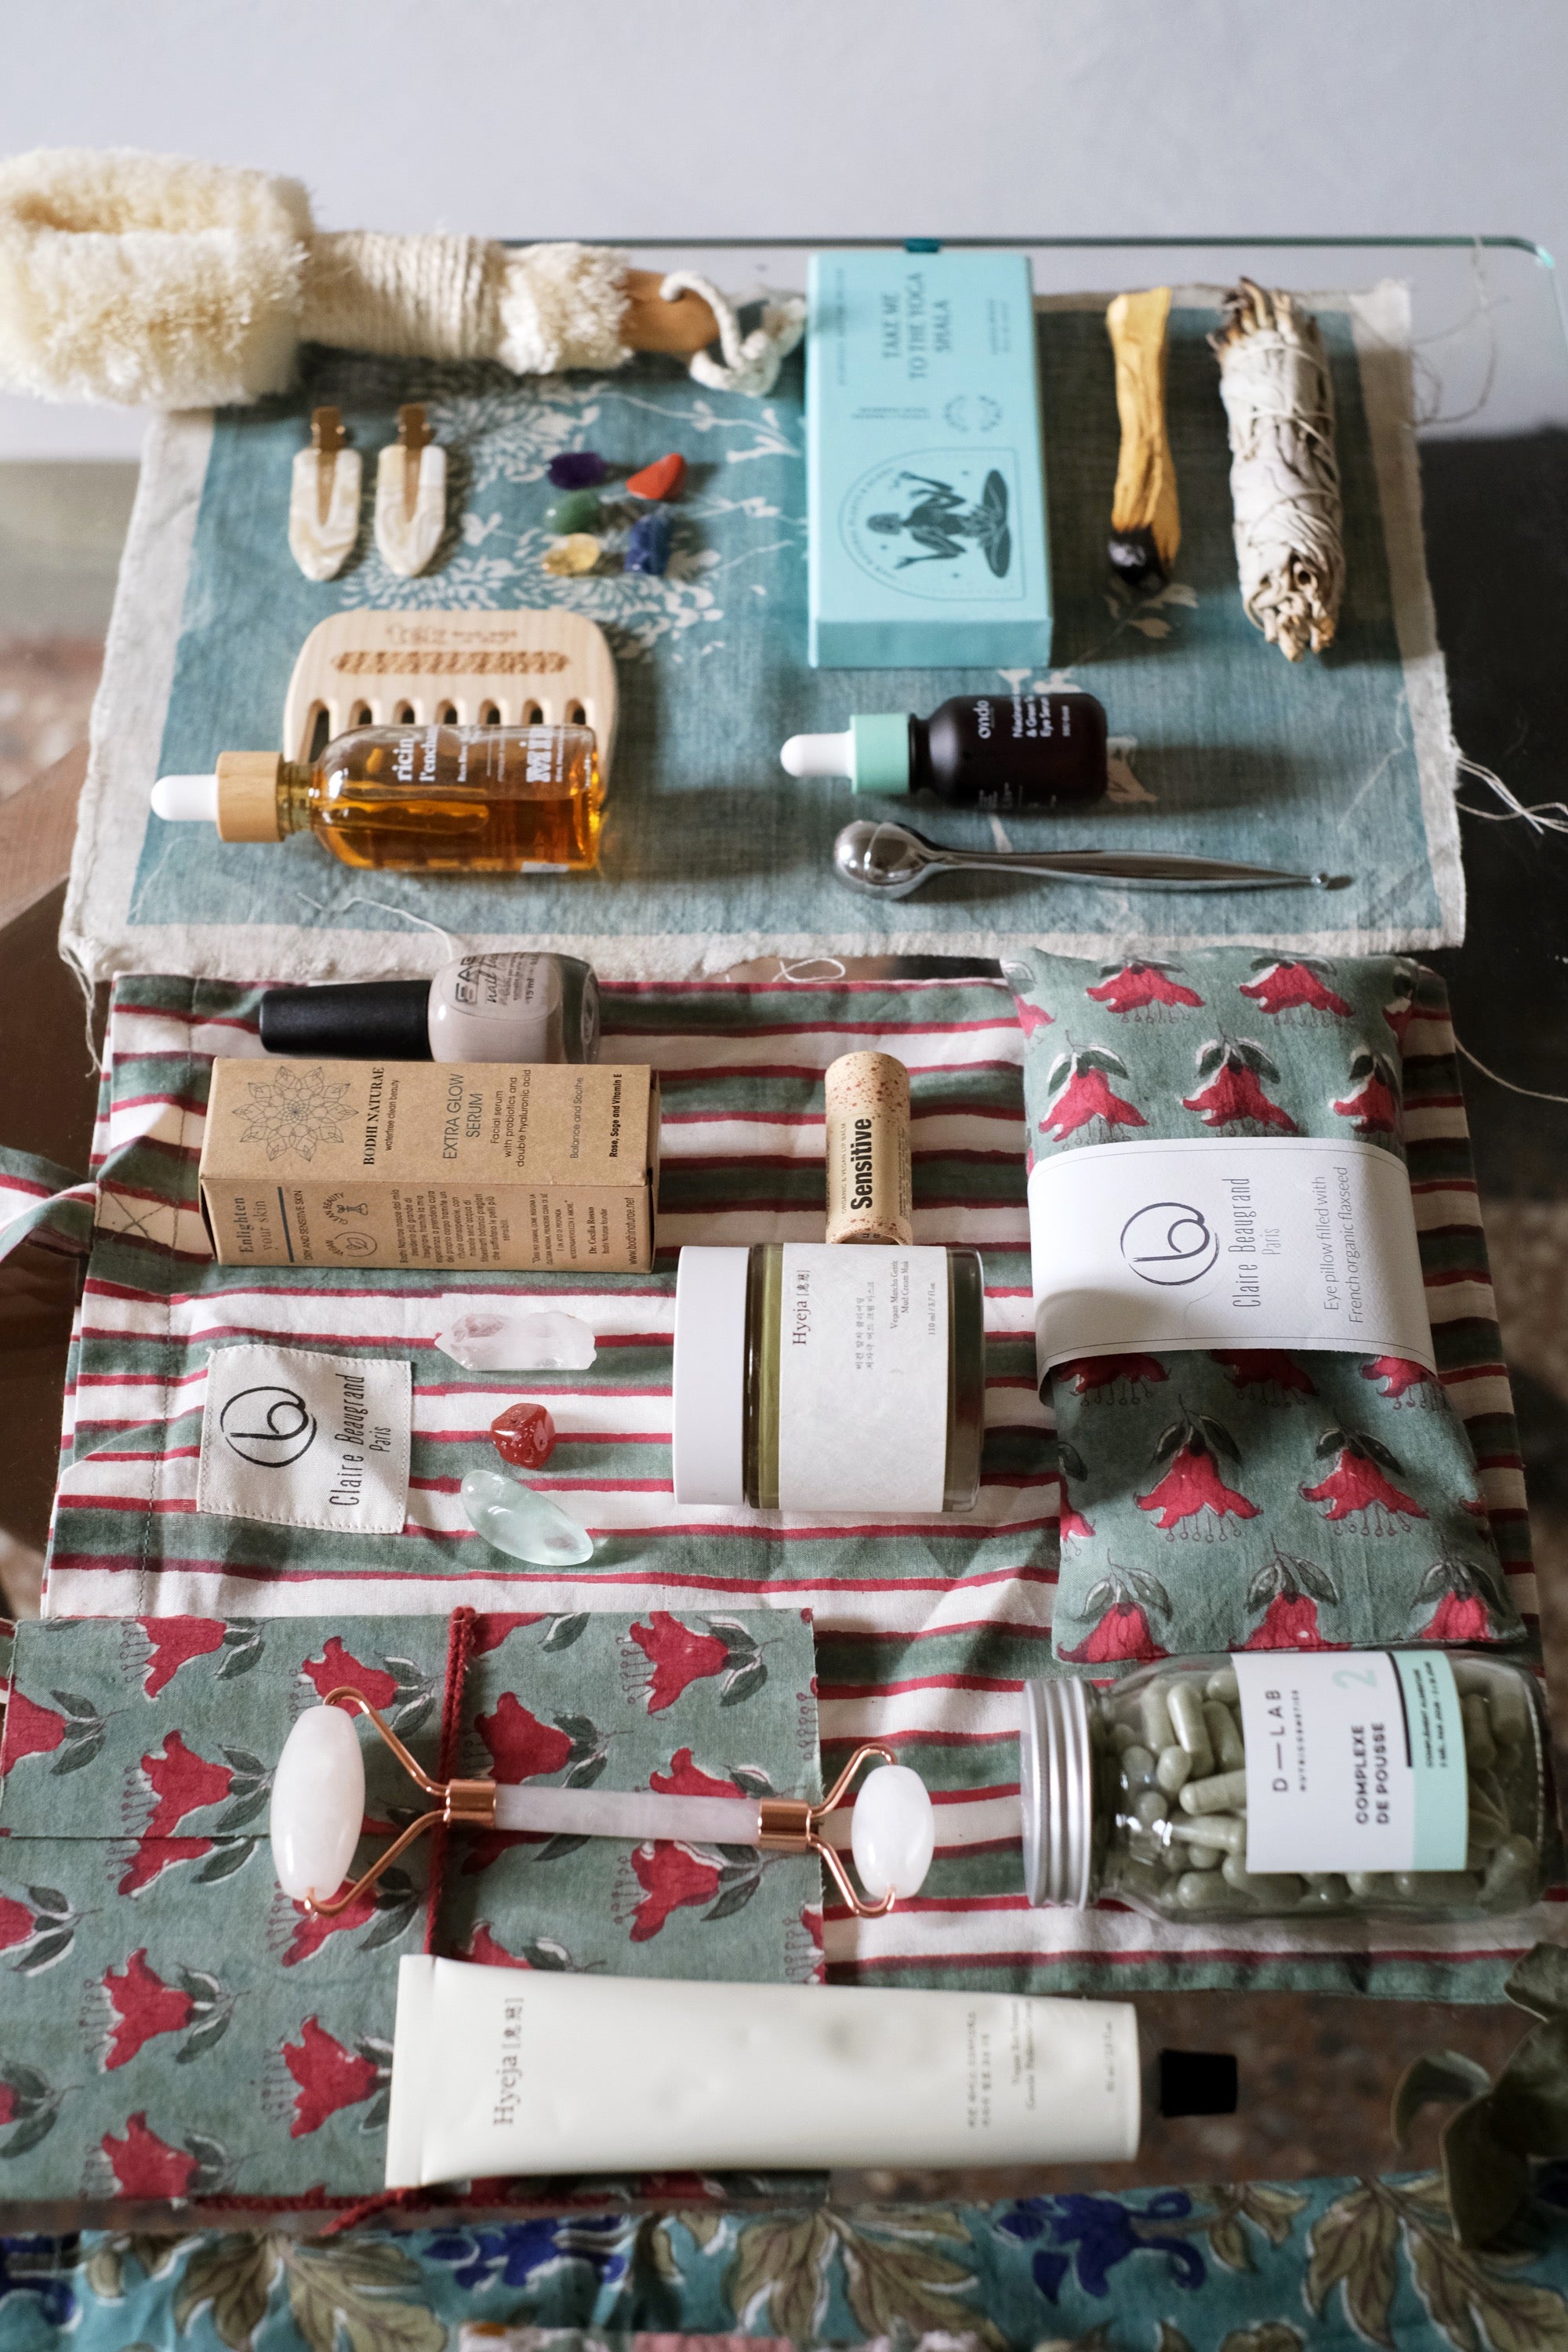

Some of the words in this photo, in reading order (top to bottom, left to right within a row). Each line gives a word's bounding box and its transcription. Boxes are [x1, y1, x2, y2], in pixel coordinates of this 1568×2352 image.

[907, 323, 926, 352] THE
[908, 356, 928, 379] TO
[972, 699, 992, 739] ondo
[392, 737, 415, 782] ricin
[390, 1080, 399, 1100] beauty
[509, 1077, 517, 1094] and
[521, 1069, 531, 1087] acid
[573, 1077, 583, 1104] Soothe
[367, 1067, 384, 1122] NATURAE
[446, 1073, 463, 1113] GLOW
[494, 1091, 503, 1116] serum
[612, 1080, 622, 1104] Vitamin
[387, 1102, 397, 1119] clean
[466, 1093, 483, 1138] SERUM
[506, 1096, 516, 1137] probiotics
[518, 1090, 530, 1133] hyaluronic
[573, 1105, 582, 1122] and
[612, 1105, 620, 1118] and
[385, 1120, 394, 1151] waterfree
[442, 1117, 460, 1159] EXTRA
[490, 1118, 501, 1144] Facial
[570, 1124, 580, 1159] Balance
[610, 1120, 621, 1137] Sage
[363, 1126, 378, 1165] BODHI
[503, 1139, 513, 1158] with
[516, 1135, 526, 1167] double
[609, 1138, 619, 1157] Rose,
[850, 1118, 873, 1210] Sensitive
[293, 1190, 304, 1205] SKIN
[322, 1192, 344, 1209] BEAUTY
[427, 1190, 436, 1203] cura
[1311, 1176, 1328, 1205] with
[1333, 1167, 1354, 1220] flaxseed
[252, 1200, 268, 1222] skin
[295, 1207, 309, 1235] SENSITIVE
[325, 1210, 348, 1225] CLEAN
[440, 1200, 449, 1219] tramite
[586, 1207, 595, 1224] Rosso
[1221, 1178, 1256, 1252] Beaugrand
[233, 1197, 255, 1253] Enlighten
[441, 1220, 452, 1236] corpo
[587, 1225, 597, 1244] Cecilia
[1314, 1208, 1331, 1240] filled
[260, 1227, 278, 1250] your
[300, 1235, 310, 1249] AND
[325, 1240, 343, 1256] VEGAN
[1260, 1229, 1281, 1254] Paris
[1339, 1224, 1360, 1273] organic
[303, 1250, 314, 1261] DRY
[1319, 1243, 1339, 1283] pillow
[1232, 1264, 1261, 1308] Claire
[1323, 1286, 1342, 1310] Eye
[1344, 1276, 1363, 1323] French
[792, 1301, 811, 1345] Hyeja
[891, 1305, 899, 1329] Vegan
[334, 1373, 368, 1446] Beaugrand
[368, 1426, 392, 1452] Paris
[328, 1454, 365, 1505] Claire
[1331, 1669, 1377, 1690] 2
[1371, 1722, 1388, 1795] POUSSE
[1351, 1725, 1369, 1824] COMPLEXE
[1376, 1801, 1389, 1824] DE
[492, 2056, 522, 2125] Hyeja
